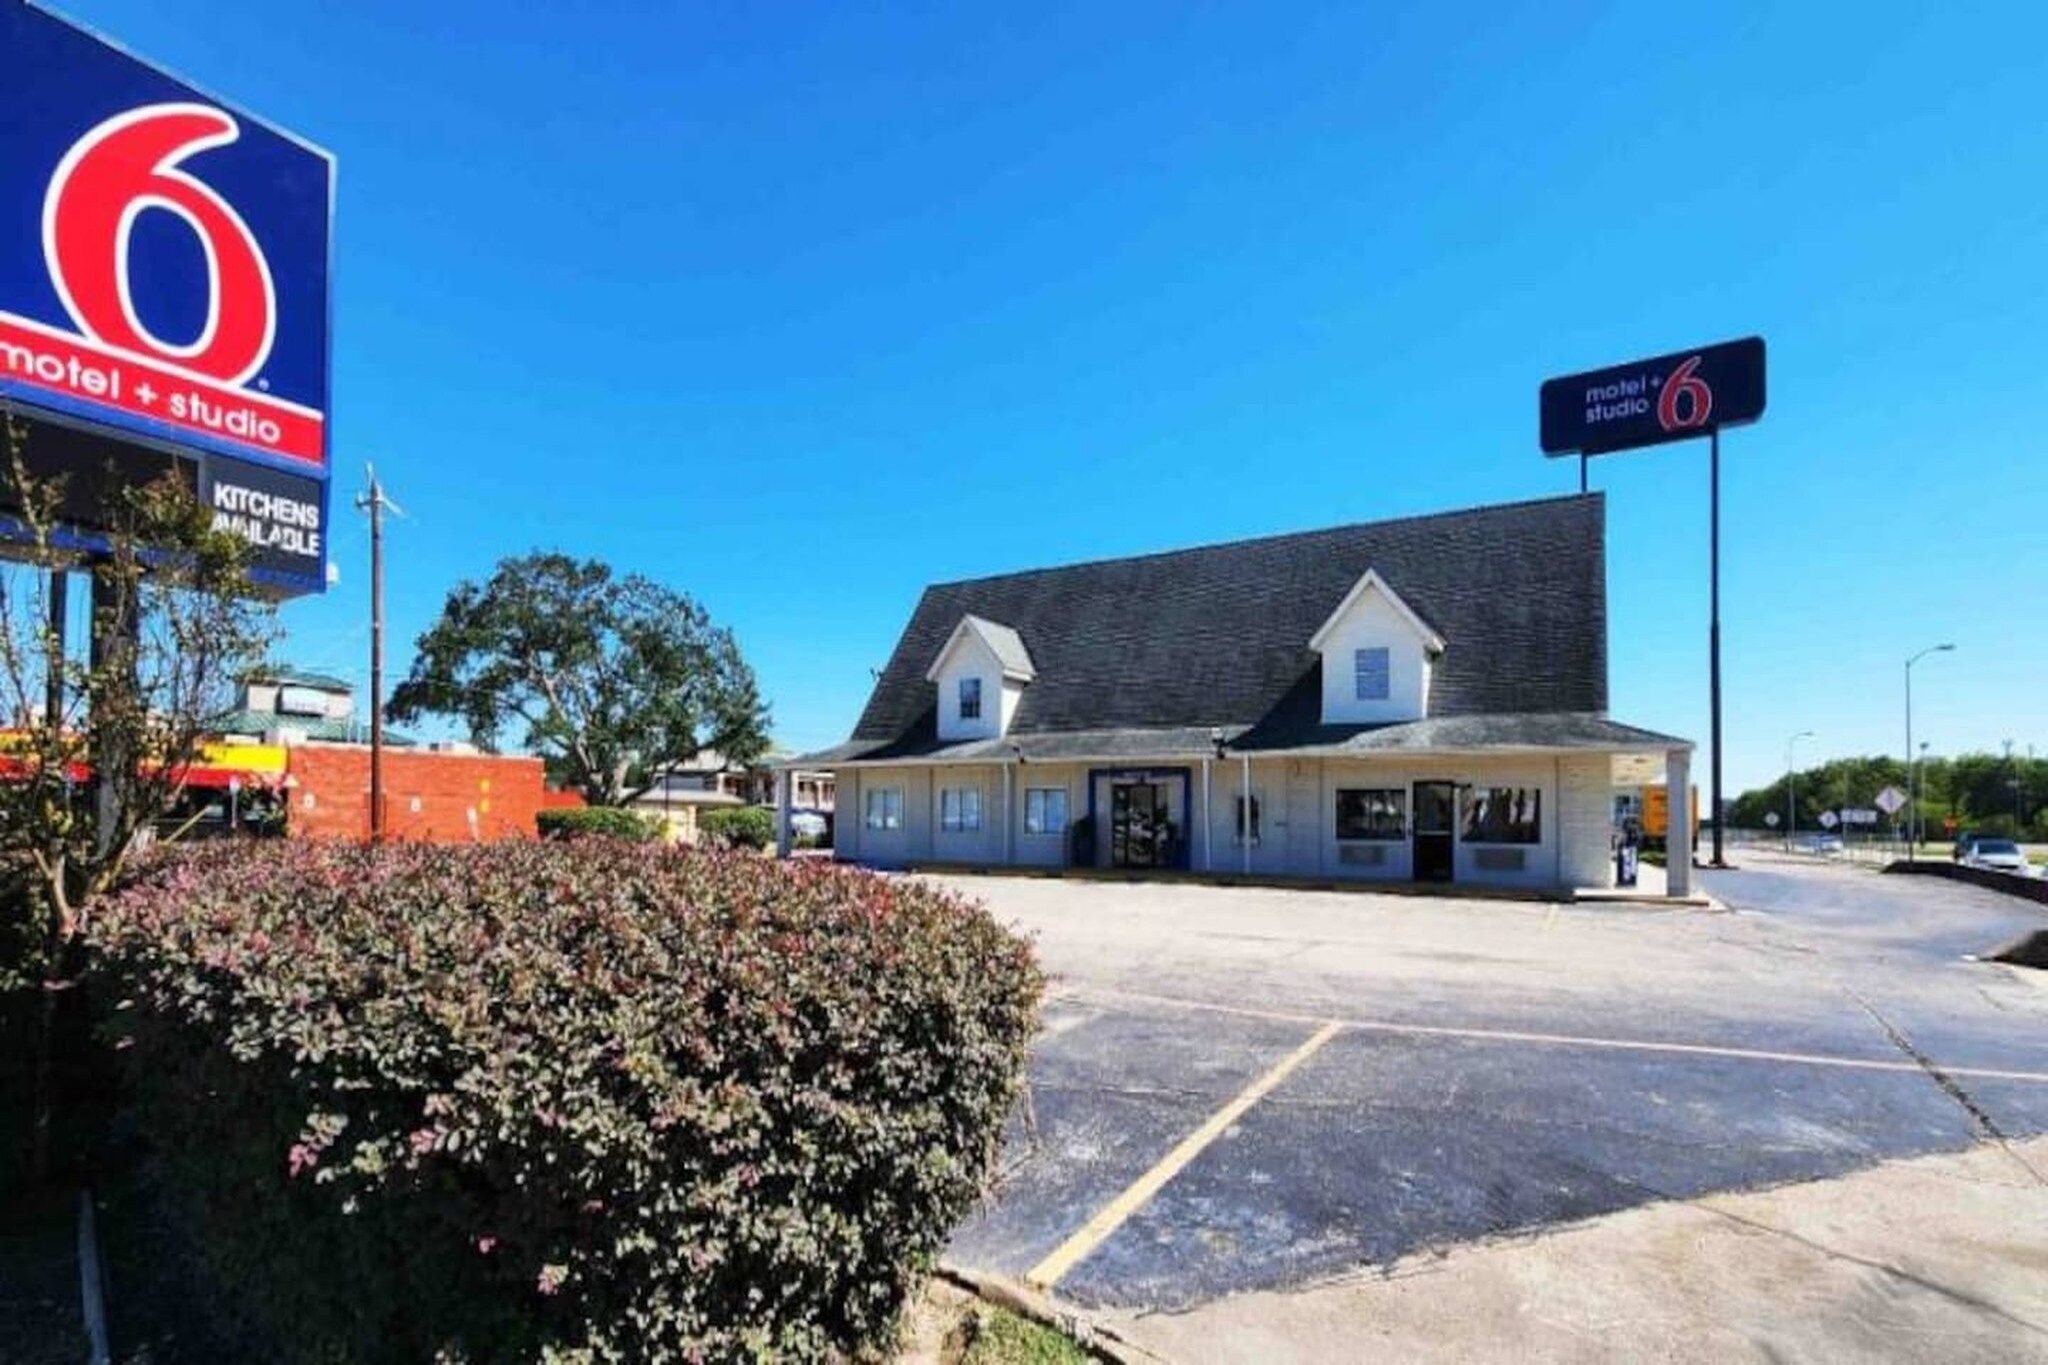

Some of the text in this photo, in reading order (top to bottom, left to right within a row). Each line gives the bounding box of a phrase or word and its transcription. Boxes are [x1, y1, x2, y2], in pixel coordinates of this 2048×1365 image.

[42, 103, 277, 389] 6
[0, 342, 120, 400] motel
[170, 391, 281, 444] studio
[1586, 376, 1646, 403] motel
[1586, 397, 1649, 424] studio
[1657, 355, 1713, 432] 6
[214, 481, 320, 529] KITCHENS
